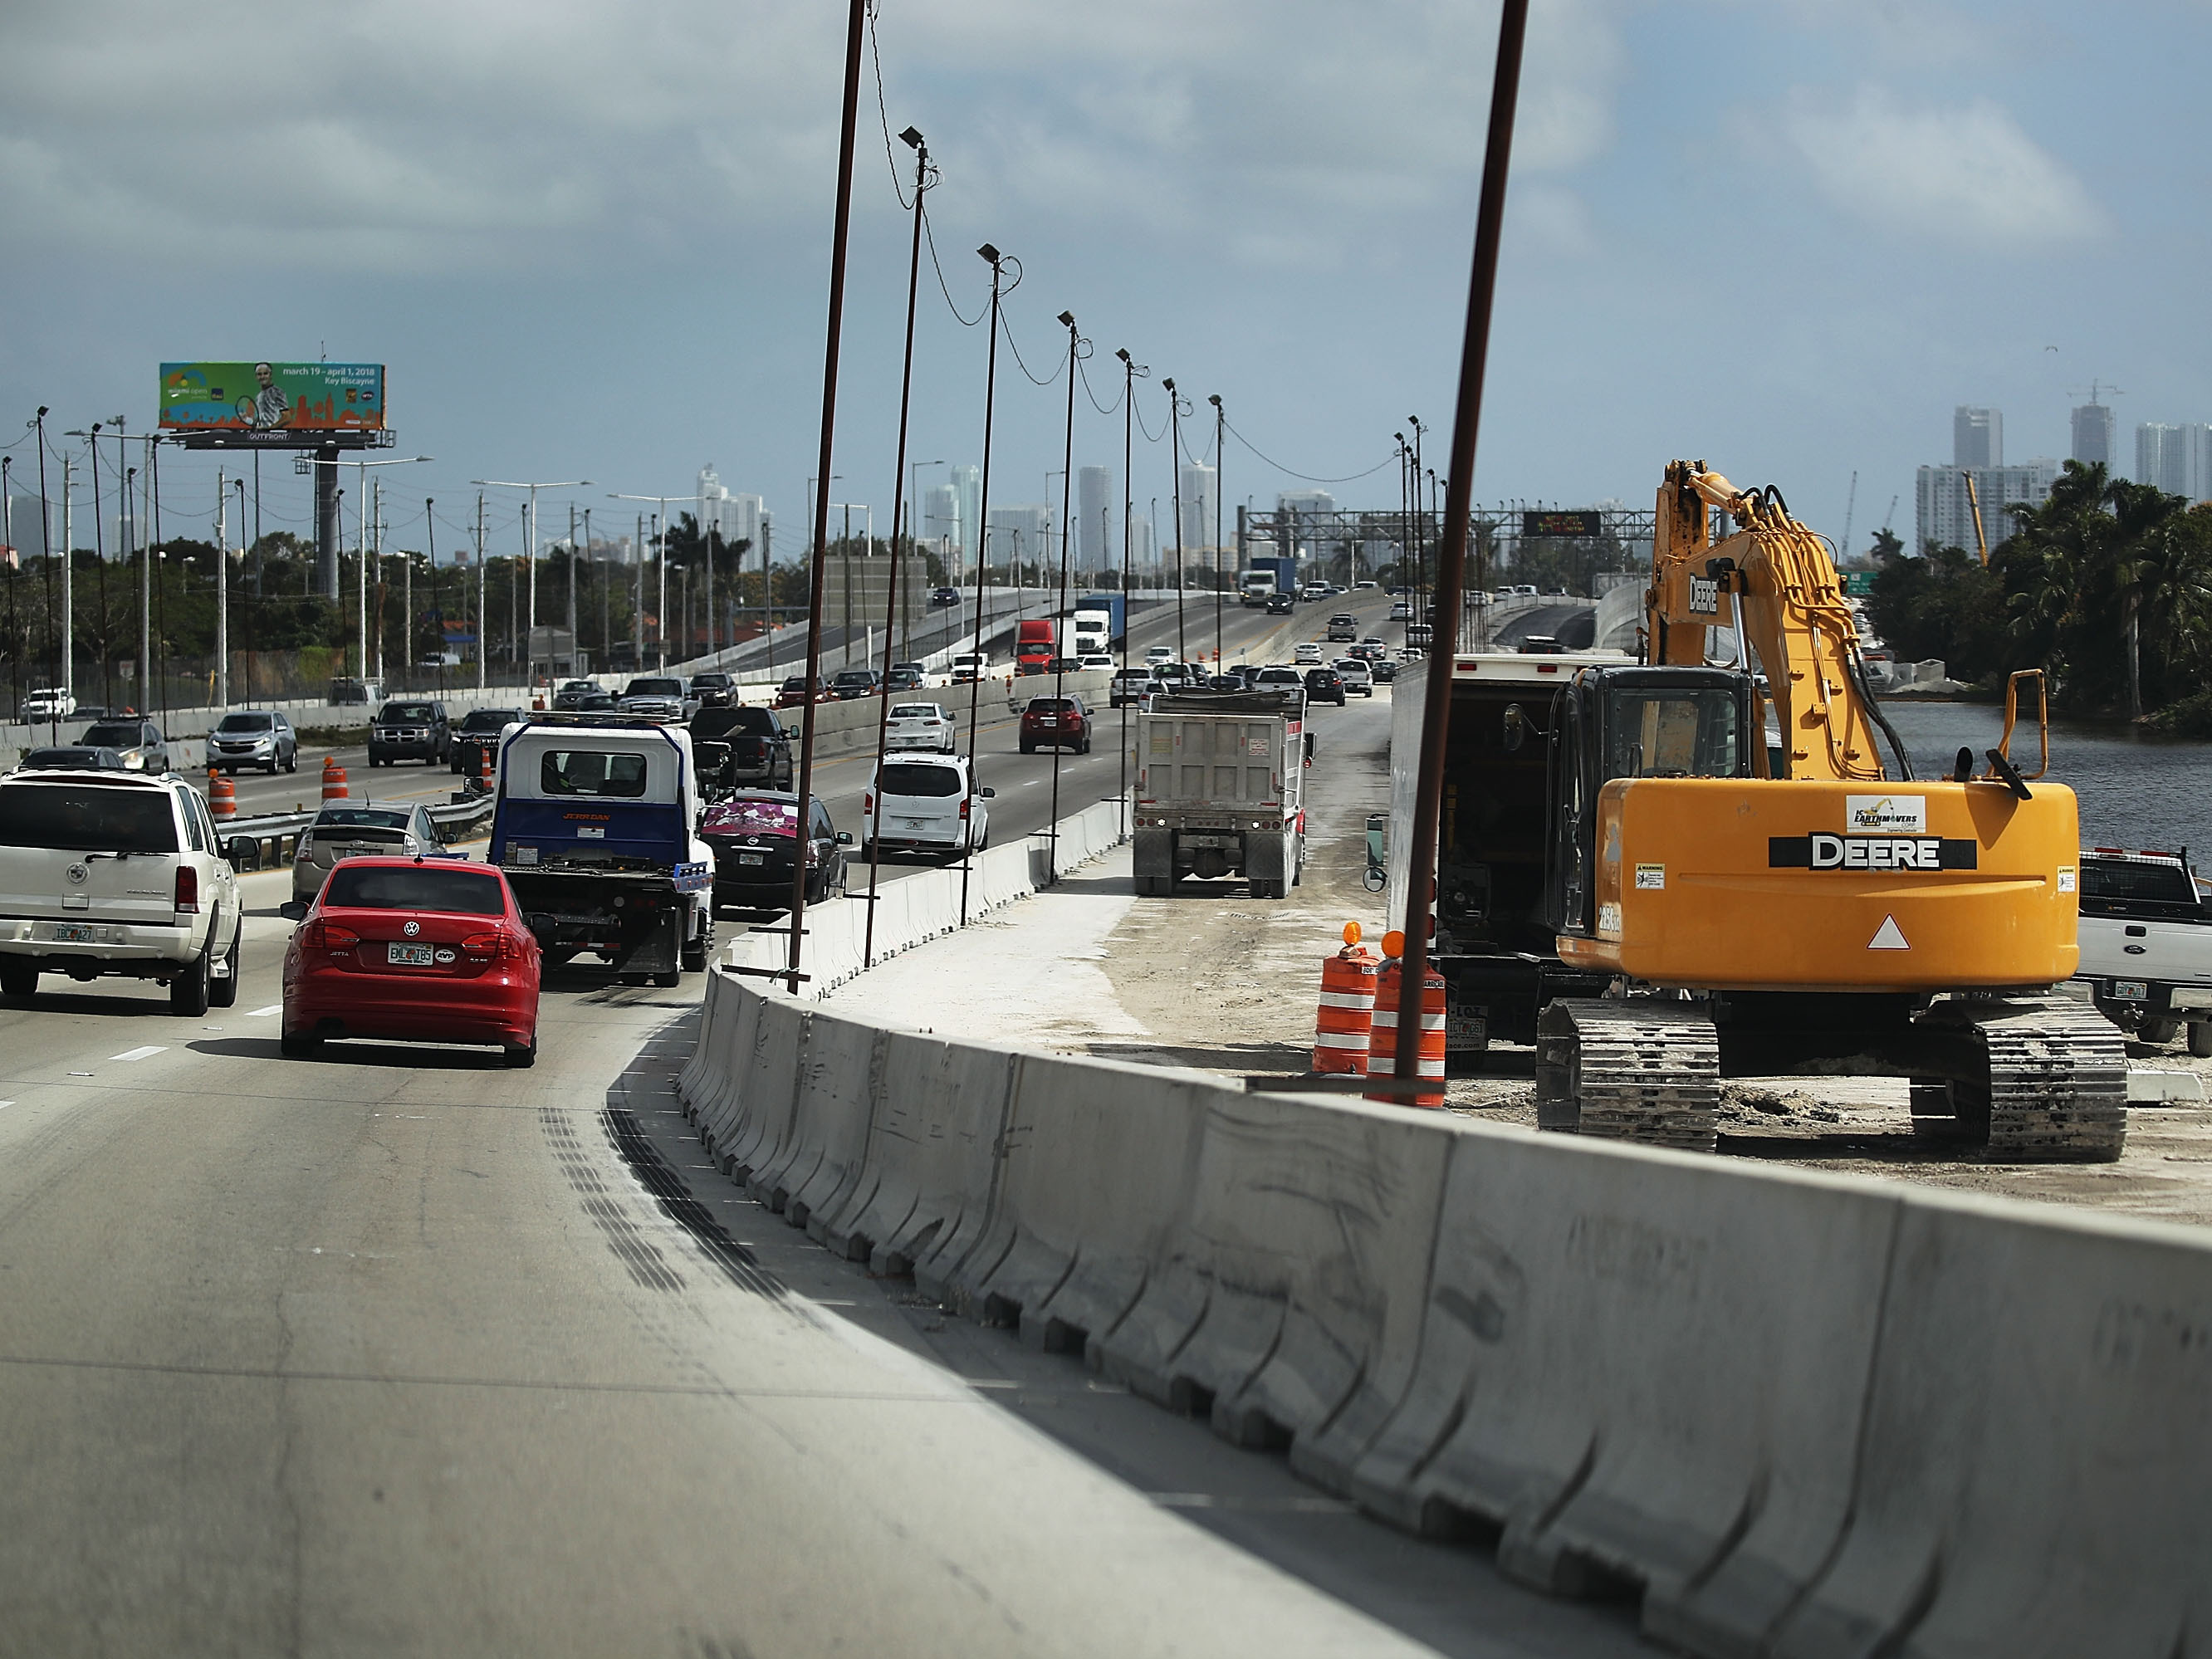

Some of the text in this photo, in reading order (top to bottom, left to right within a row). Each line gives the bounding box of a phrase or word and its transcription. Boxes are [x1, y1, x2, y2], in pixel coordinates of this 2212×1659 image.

[327, 368, 346, 377] april
[348, 368, 355, 376] 1,
[325, 378, 374, 386] Key Biscayne
[1690, 575, 1717, 612] DEERE
[1853, 815, 1917, 824] EARTHMOVERS
[1813, 835, 1940, 867] DEERE
[416, 948, 431, 960] T85
[1450, 1022, 1482, 1034] ICT G61
